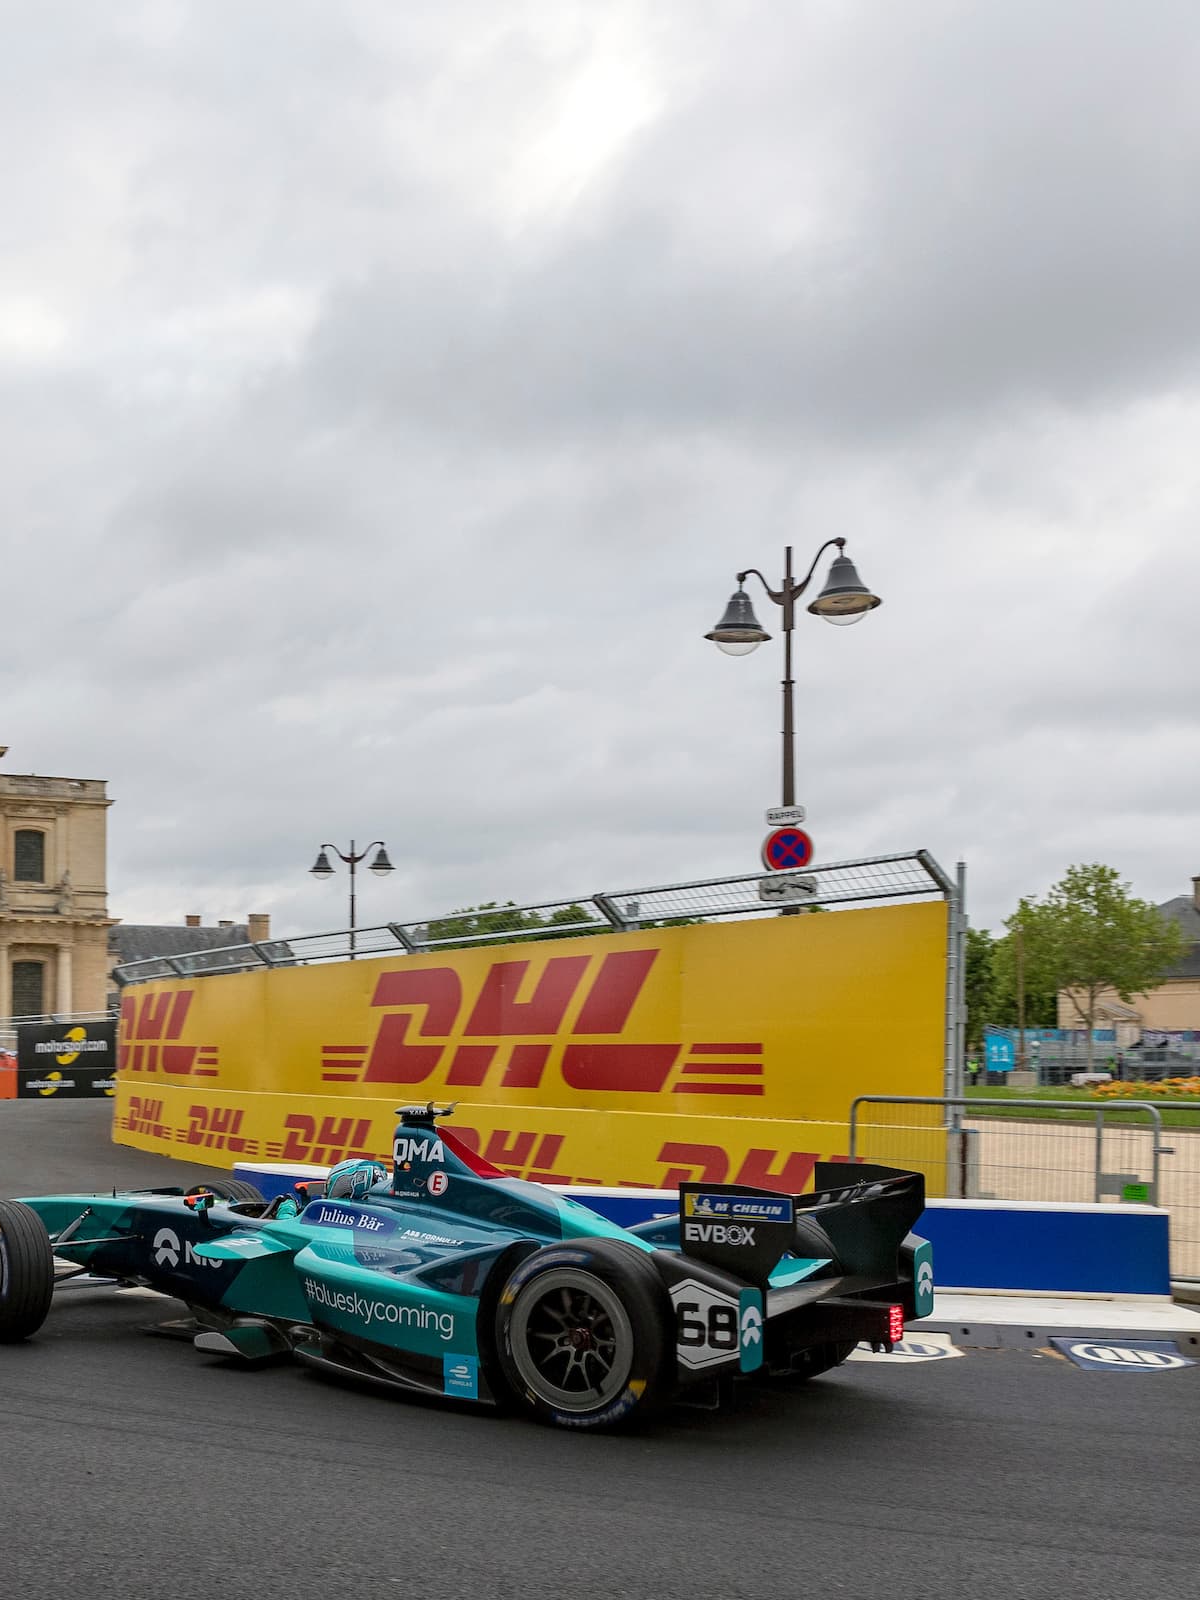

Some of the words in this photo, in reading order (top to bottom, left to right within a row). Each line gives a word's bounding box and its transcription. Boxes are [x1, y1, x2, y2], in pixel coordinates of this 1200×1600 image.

[767, 810, 803, 820] RAPPEL
[362, 949, 682, 1092] DHL
[35, 1040, 108, 1054] motorsport.com
[128, 1096, 165, 1138] DHL
[187, 1105, 247, 1153] DHL
[281, 1114, 375, 1165] DHL
[392, 1138, 445, 1165] QMA
[432, 1175, 443, 1192] E
[319, 1206, 355, 1226] Julius
[357, 1214, 384, 1232] Bär
[714, 1202, 782, 1215] MCHELIN
[685, 1223, 756, 1246] EVBOX
[304, 1277, 454, 1340] #blueskycoming
[677, 1302, 738, 1350] 68
